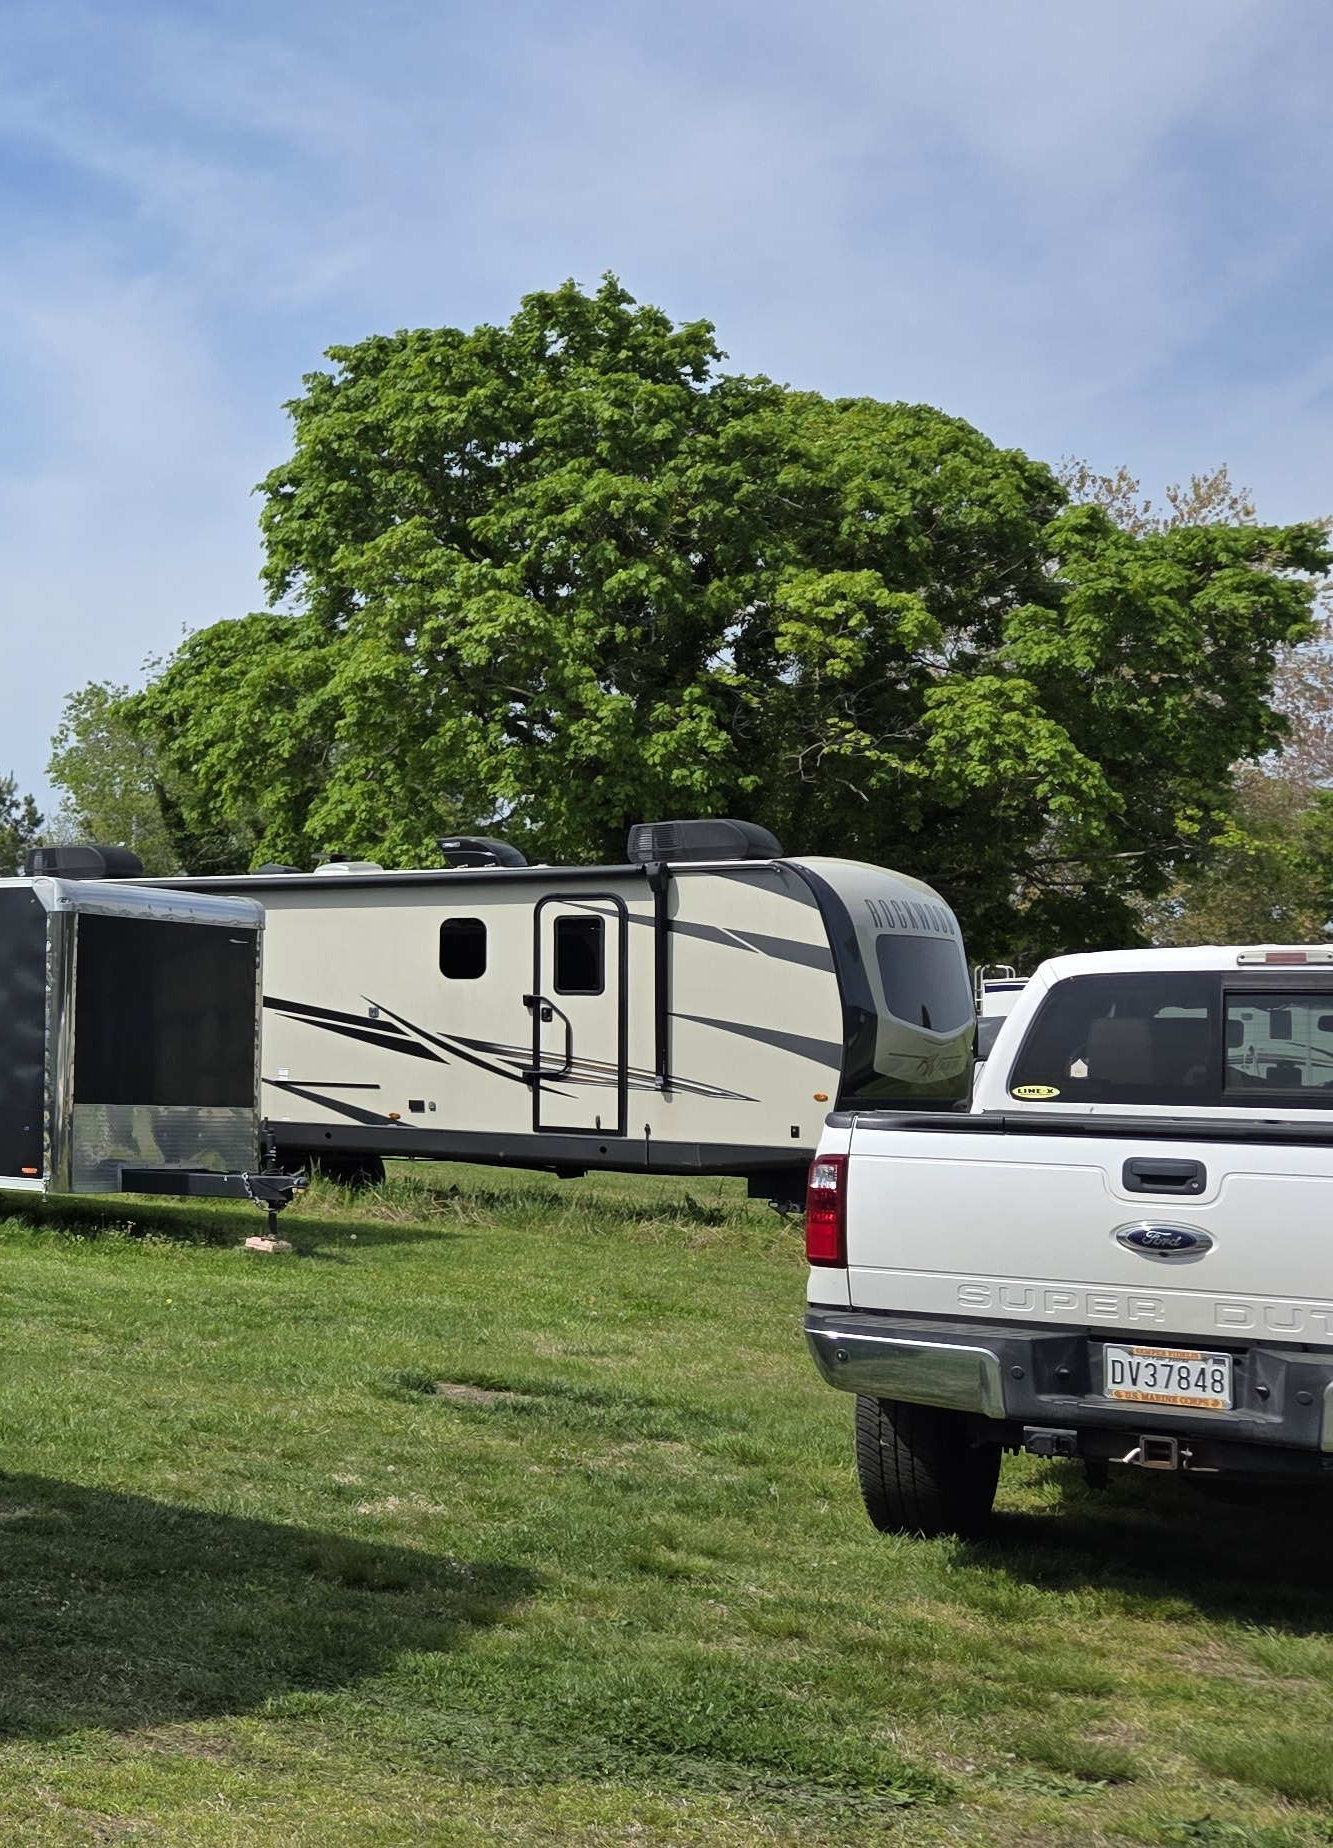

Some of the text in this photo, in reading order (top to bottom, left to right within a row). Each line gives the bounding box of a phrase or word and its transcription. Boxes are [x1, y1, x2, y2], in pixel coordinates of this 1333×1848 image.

[864, 899, 955, 935] ROCKWOOD
[1141, 1230, 1182, 1247] Ford
[957, 1283, 1166, 1323] SUPER
[1111, 1359, 1225, 1394] DV37848
[1141, 1393, 1178, 1403] MARINE
[1179, 1396, 1210, 1407] CORPS
